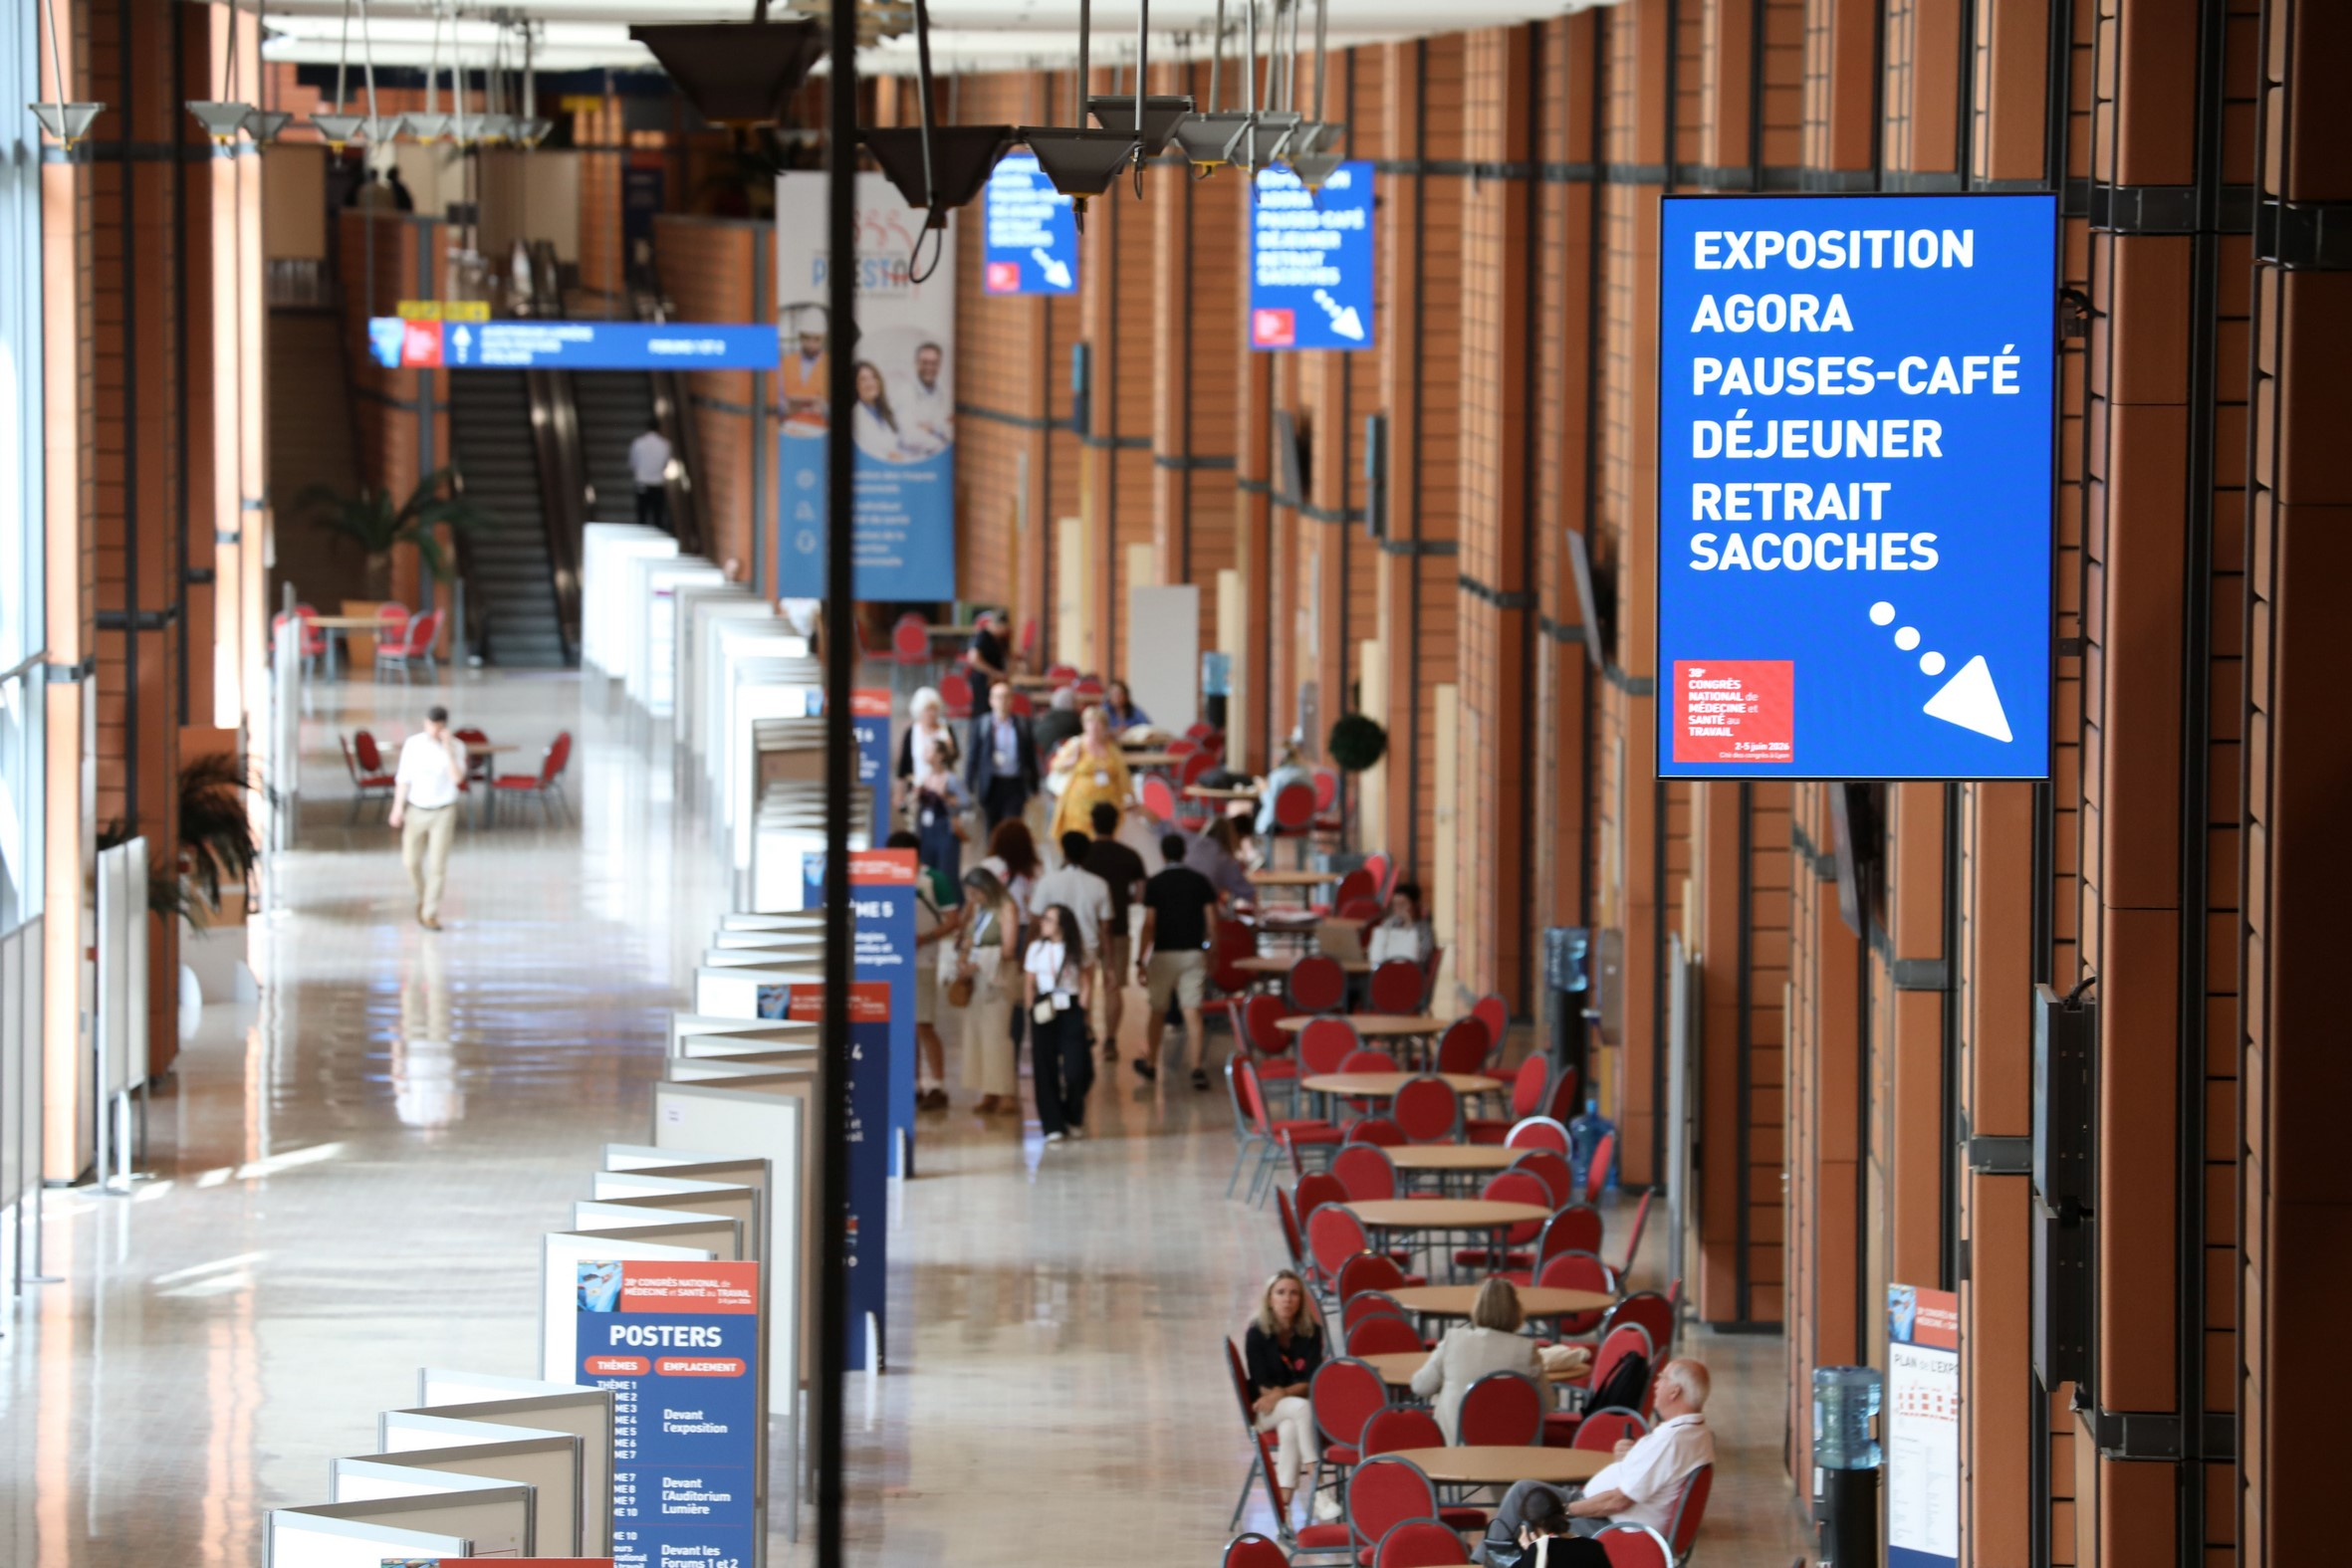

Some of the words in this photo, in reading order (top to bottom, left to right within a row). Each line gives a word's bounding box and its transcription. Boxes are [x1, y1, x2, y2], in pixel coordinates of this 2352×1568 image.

[1695, 229, 1974, 270] EXPOSITION
[1691, 294, 1854, 333] AGORA
[1693, 343, 2020, 395] PAUSES-CAFÉ
[1692, 408, 1943, 459] DÉJEUNER
[1692, 483, 1891, 521] RETRAIT
[1689, 533, 1939, 571] SACOCHES
[1688, 692, 1744, 701] NATIONAL
[1688, 701, 1747, 713] MÉDECINE
[1688, 713, 1726, 725] SANTÉ
[1688, 727, 1734, 737] TRAVAIL
[851, 1043, 862, 1060] 4
[609, 1325, 722, 1347] POSTERS
[597, 1359, 637, 1371] THÈMES
[663, 1362, 737, 1372] EMPLACEMENT
[631, 1381, 637, 1390] 1
[663, 1409, 704, 1420] Devant
[663, 1422, 728, 1435] l'exposition
[662, 1476, 702, 1488] Devant
[662, 1490, 732, 1501] l'Auditorium
[662, 1502, 710, 1514] Lumière
[661, 1544, 701, 1556] Devant
[702, 1545, 721, 1556] les
